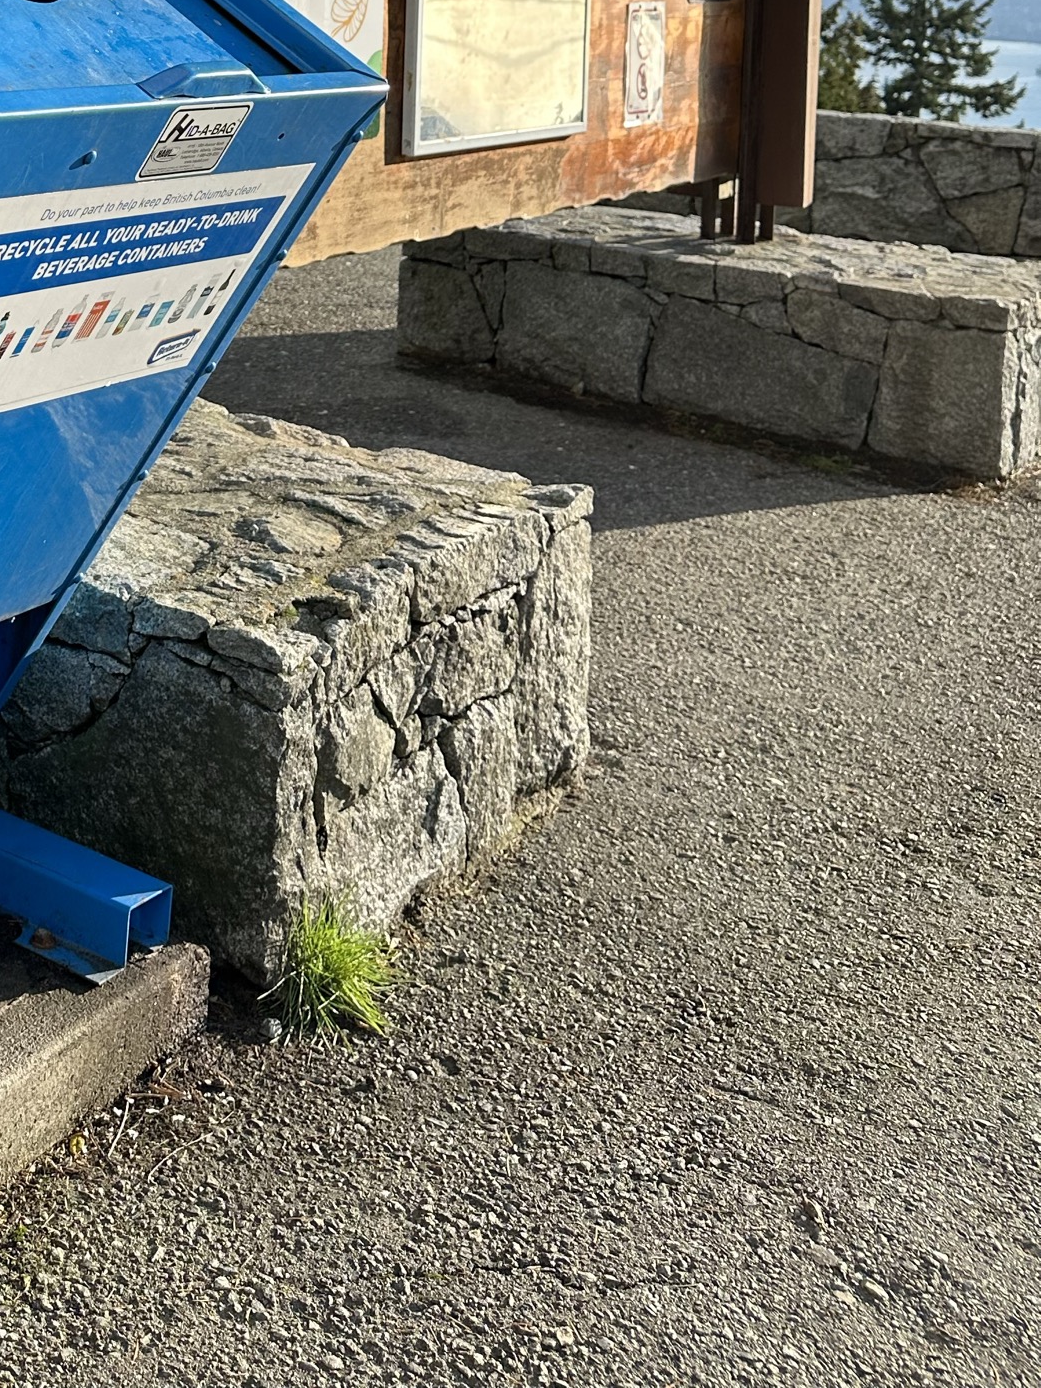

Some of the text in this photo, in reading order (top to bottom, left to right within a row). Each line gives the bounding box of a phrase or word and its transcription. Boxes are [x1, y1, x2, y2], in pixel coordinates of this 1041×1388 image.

[165, 113, 236, 142] HID-A-BAG
[40, 182, 262, 222] Do your part to help keep British Columbia clean!
[67, 229, 99, 251] ALL
[102, 224, 145, 245] YOUR
[143, 207, 264, 240] READY-TO-DRINK
[31, 236, 209, 280] BEVERAGE CONTAINERS
